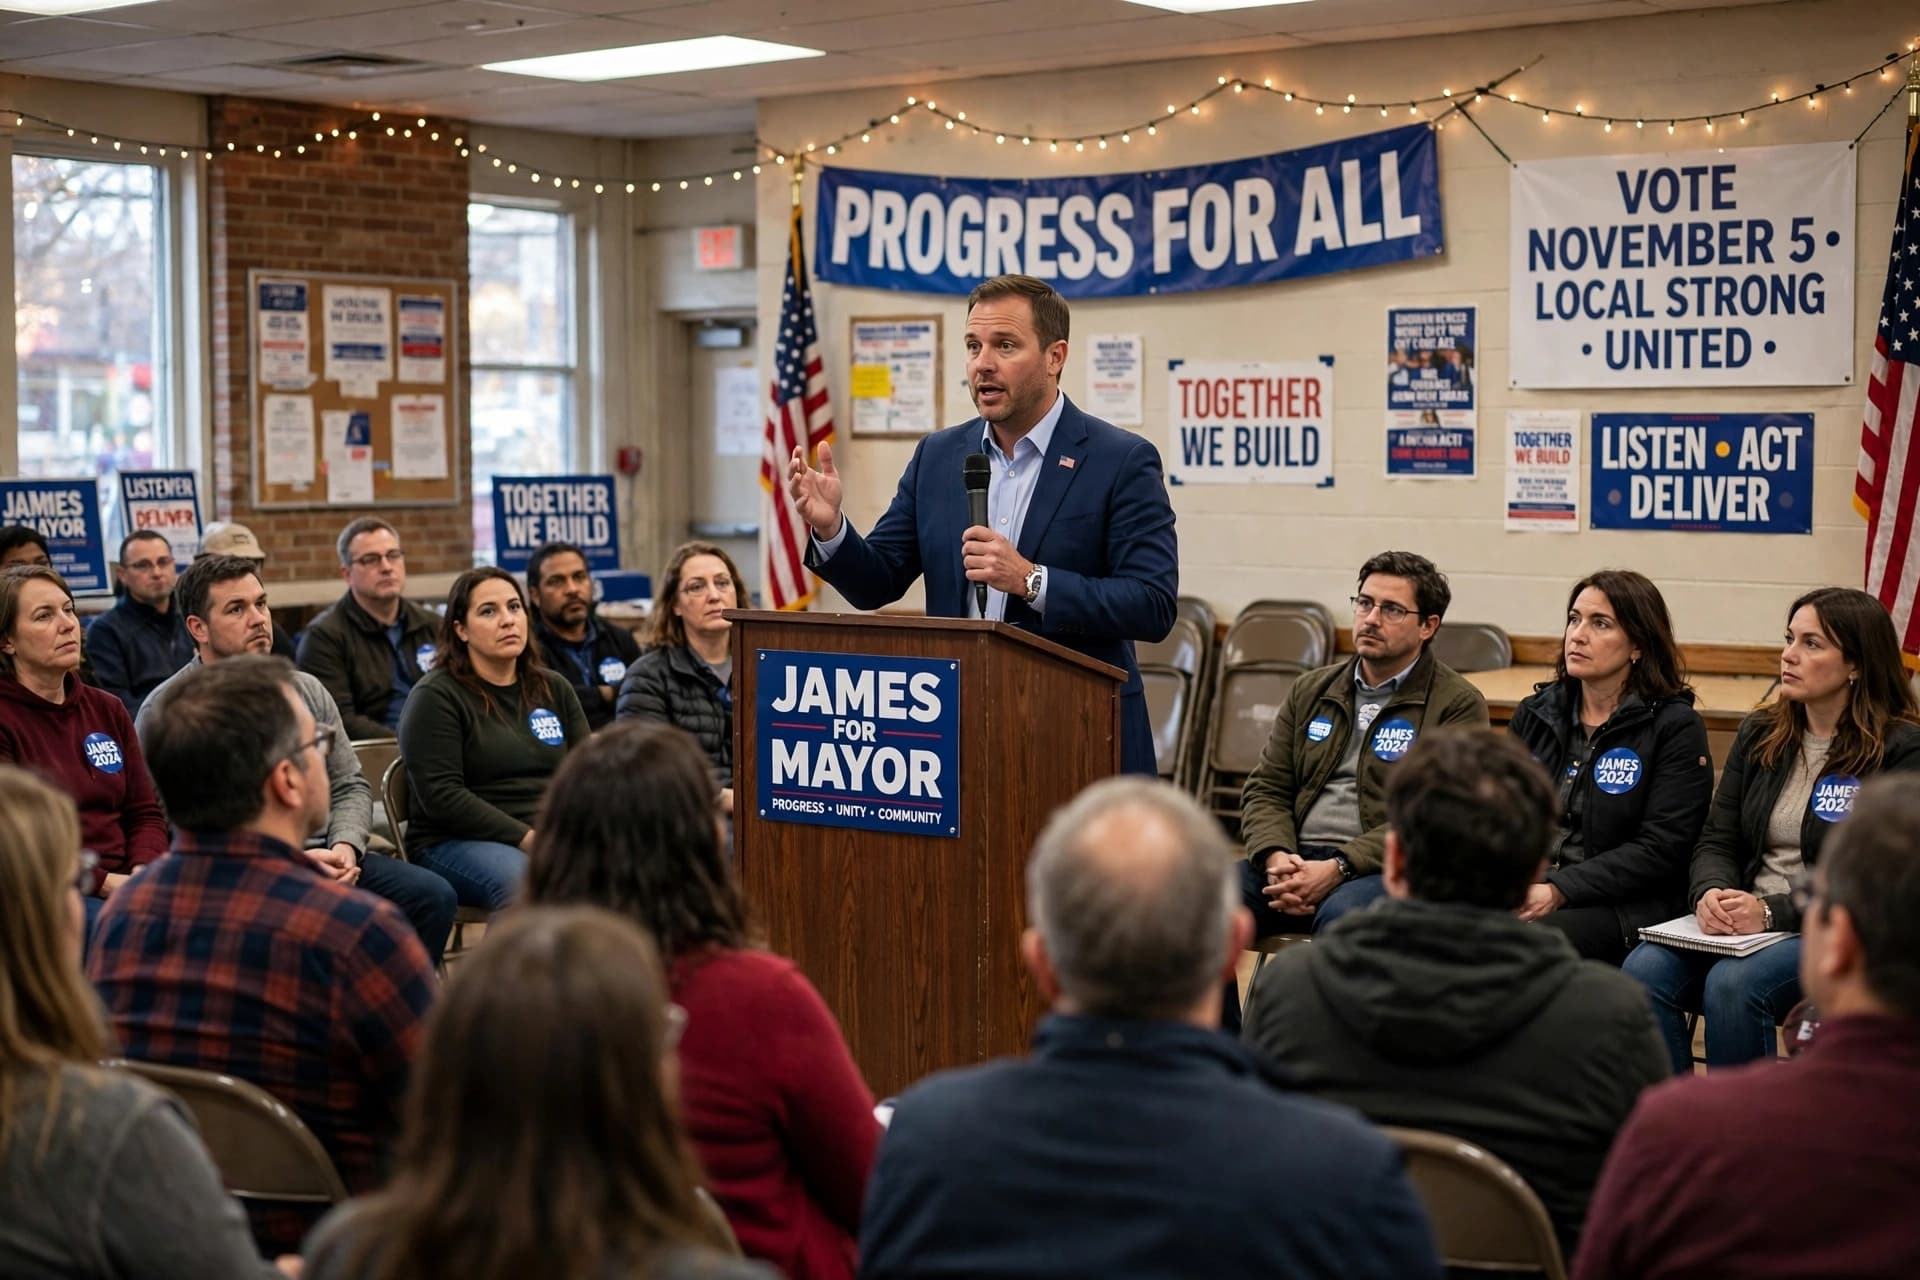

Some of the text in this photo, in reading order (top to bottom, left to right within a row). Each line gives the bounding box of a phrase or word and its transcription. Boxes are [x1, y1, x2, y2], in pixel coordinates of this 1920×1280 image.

[1616, 164, 1736, 215] VOTE
[832, 186, 1134, 280] PROGRESS
[1152, 178, 1278, 274] FOR
[1295, 150, 1421, 256] ALL
[1528, 217, 1815, 272] NOVEMBER 5
[1536, 272, 1825, 320] LOCAL STRONG
[1606, 327, 1752, 370] UNITED
[1178, 377, 1322, 419] TOGETHER
[1181, 425, 1320, 467] WE BUILD
[1514, 431, 1572, 448] TOGETHER
[1601, 426, 1803, 471] LISTEN ACT
[1515, 449, 1571, 464] WE BUILD
[2, 489, 85, 519] JAMES
[500, 483, 610, 514] TOGETHER
[1630, 475, 1770, 522] DELIVER
[135, 509, 194, 529] DELIVER
[505, 514, 610, 548] WE BUILD
[771, 665, 942, 723] JAMES
[833, 718, 877, 742] FOR
[1374, 727, 1414, 741] JAMES
[86, 740, 118, 756] JAMES
[92, 752, 122, 767] 2024
[1374, 739, 1408, 753] 2024
[771, 738, 943, 799] MAYOR
[1597, 757, 1639, 771] JAMES
[1597, 770, 1634, 785] 2024
[772, 797, 942, 825] PROGRESS UNITY COMMUNITY
